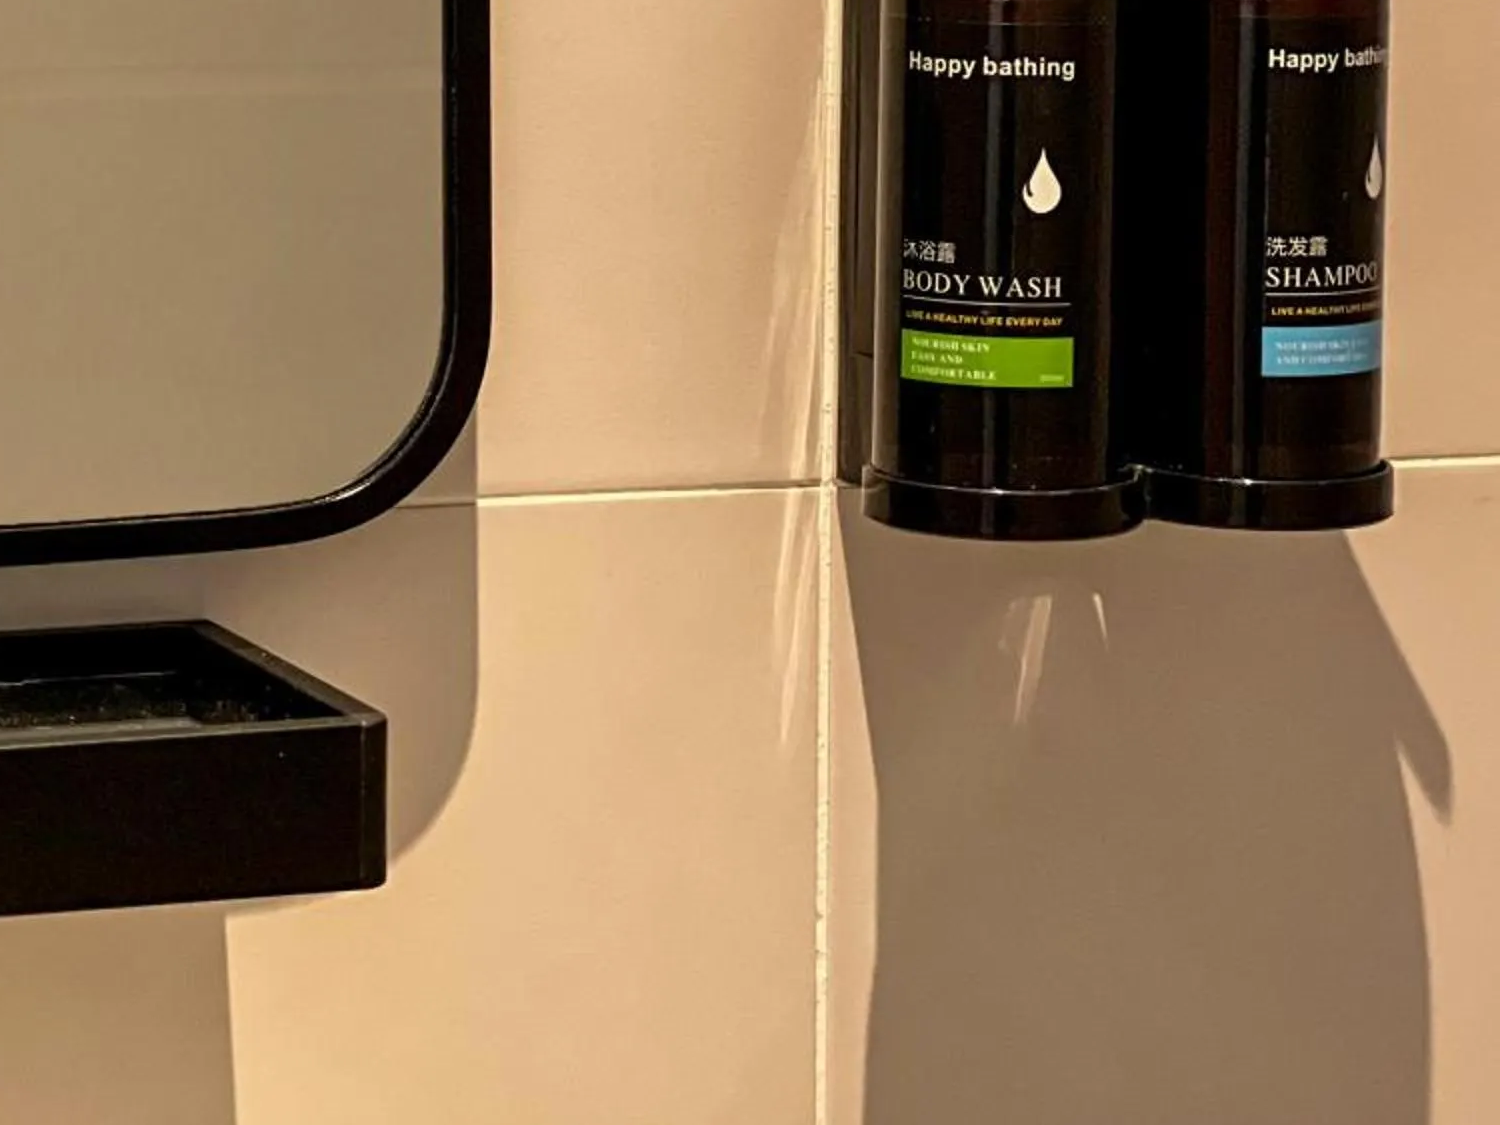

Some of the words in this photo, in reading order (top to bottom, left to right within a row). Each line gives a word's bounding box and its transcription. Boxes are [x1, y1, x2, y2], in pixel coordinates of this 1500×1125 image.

[909, 50, 976, 80] Happy
[983, 55, 1076, 82] bathing
[1268, 48, 1339, 73] Happy
[903, 239, 956, 264] 沐浴露
[1266, 236, 1328, 257] 洗发露
[903, 268, 971, 295] BODY
[978, 276, 1062, 298] WASH
[1265, 261, 1378, 288] SHAMPOO
[925, 311, 931, 321] A
[932, 313, 978, 325] HEALTHY
[980, 316, 1002, 326] LIFE
[1006, 316, 1041, 327] EVERY
[1043, 317, 1064, 327] DAY
[1271, 306, 1294, 316] LIVE
[1296, 306, 1303, 316] A
[940, 354, 963, 364] AND
